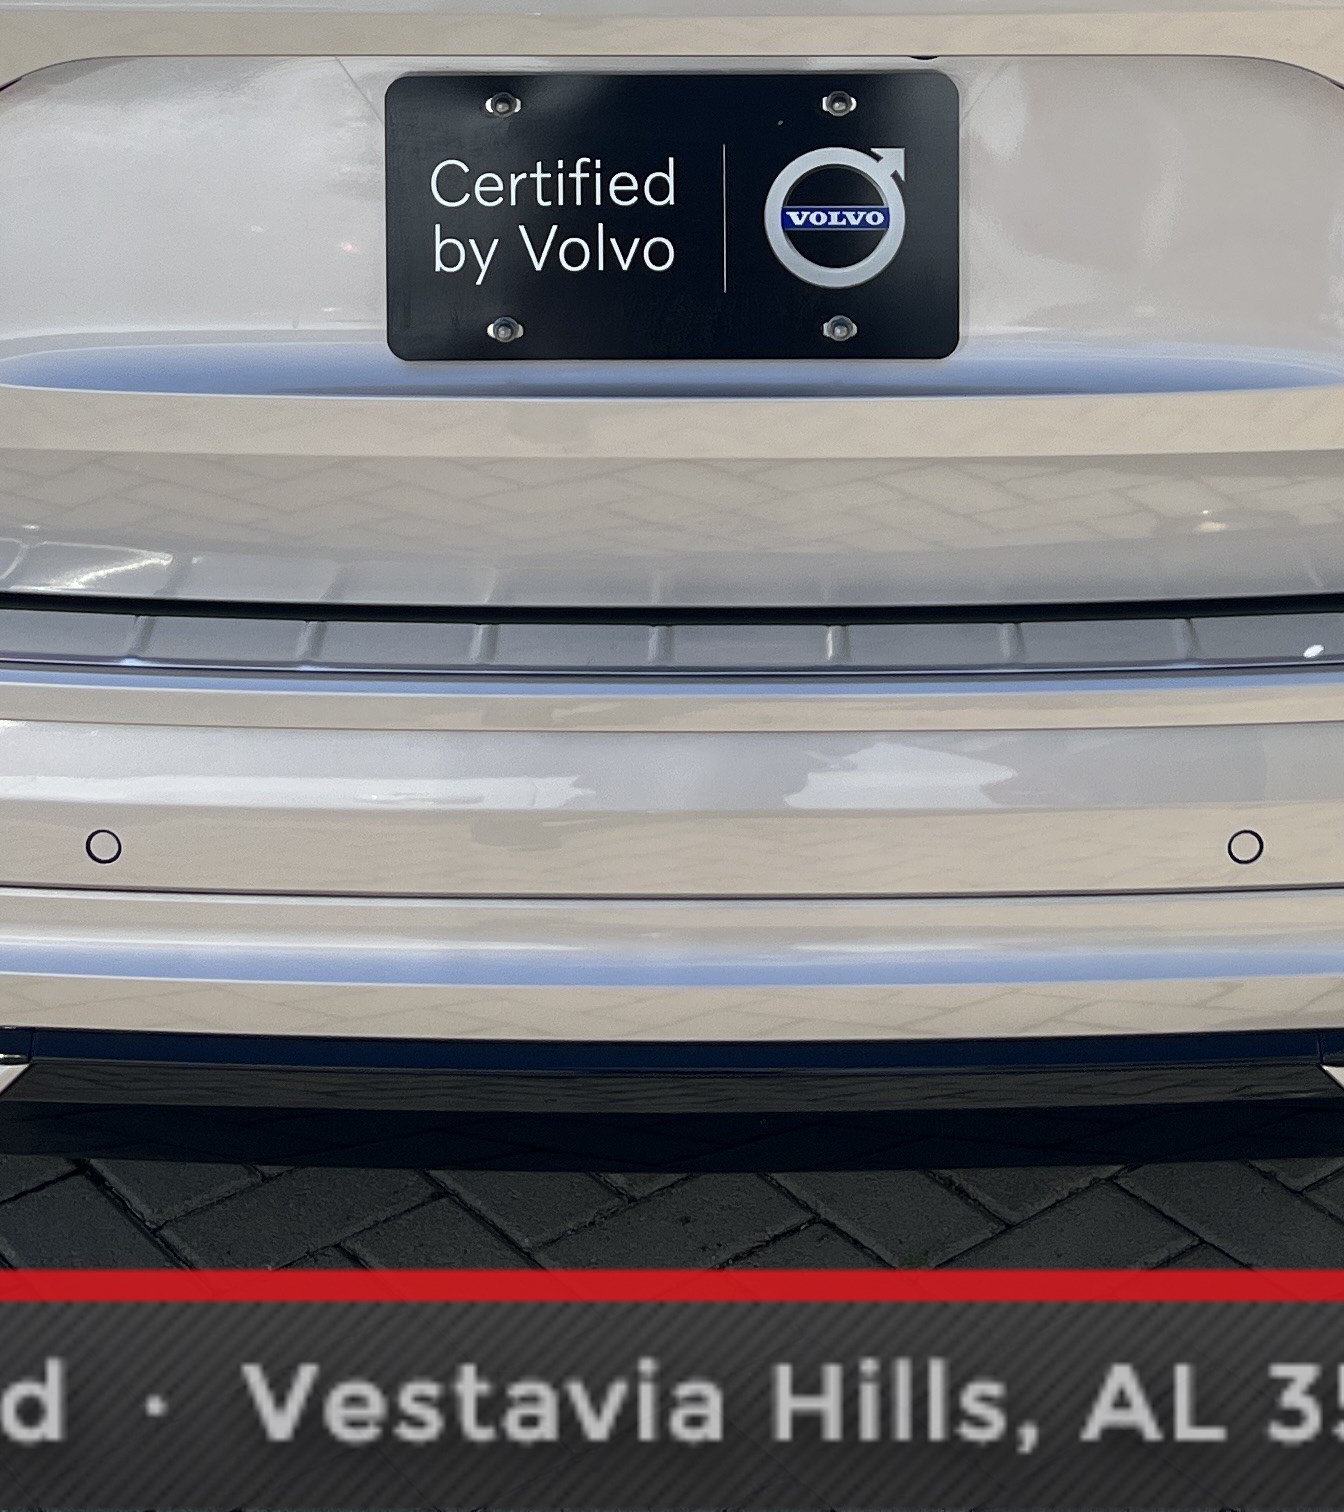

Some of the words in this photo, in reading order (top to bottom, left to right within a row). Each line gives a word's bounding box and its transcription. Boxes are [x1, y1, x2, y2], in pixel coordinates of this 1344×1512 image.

[429, 156, 676, 208] Certified
[785, 211, 885, 226] VOLVO
[433, 223, 499, 286] by
[518, 222, 676, 272] Volvo
